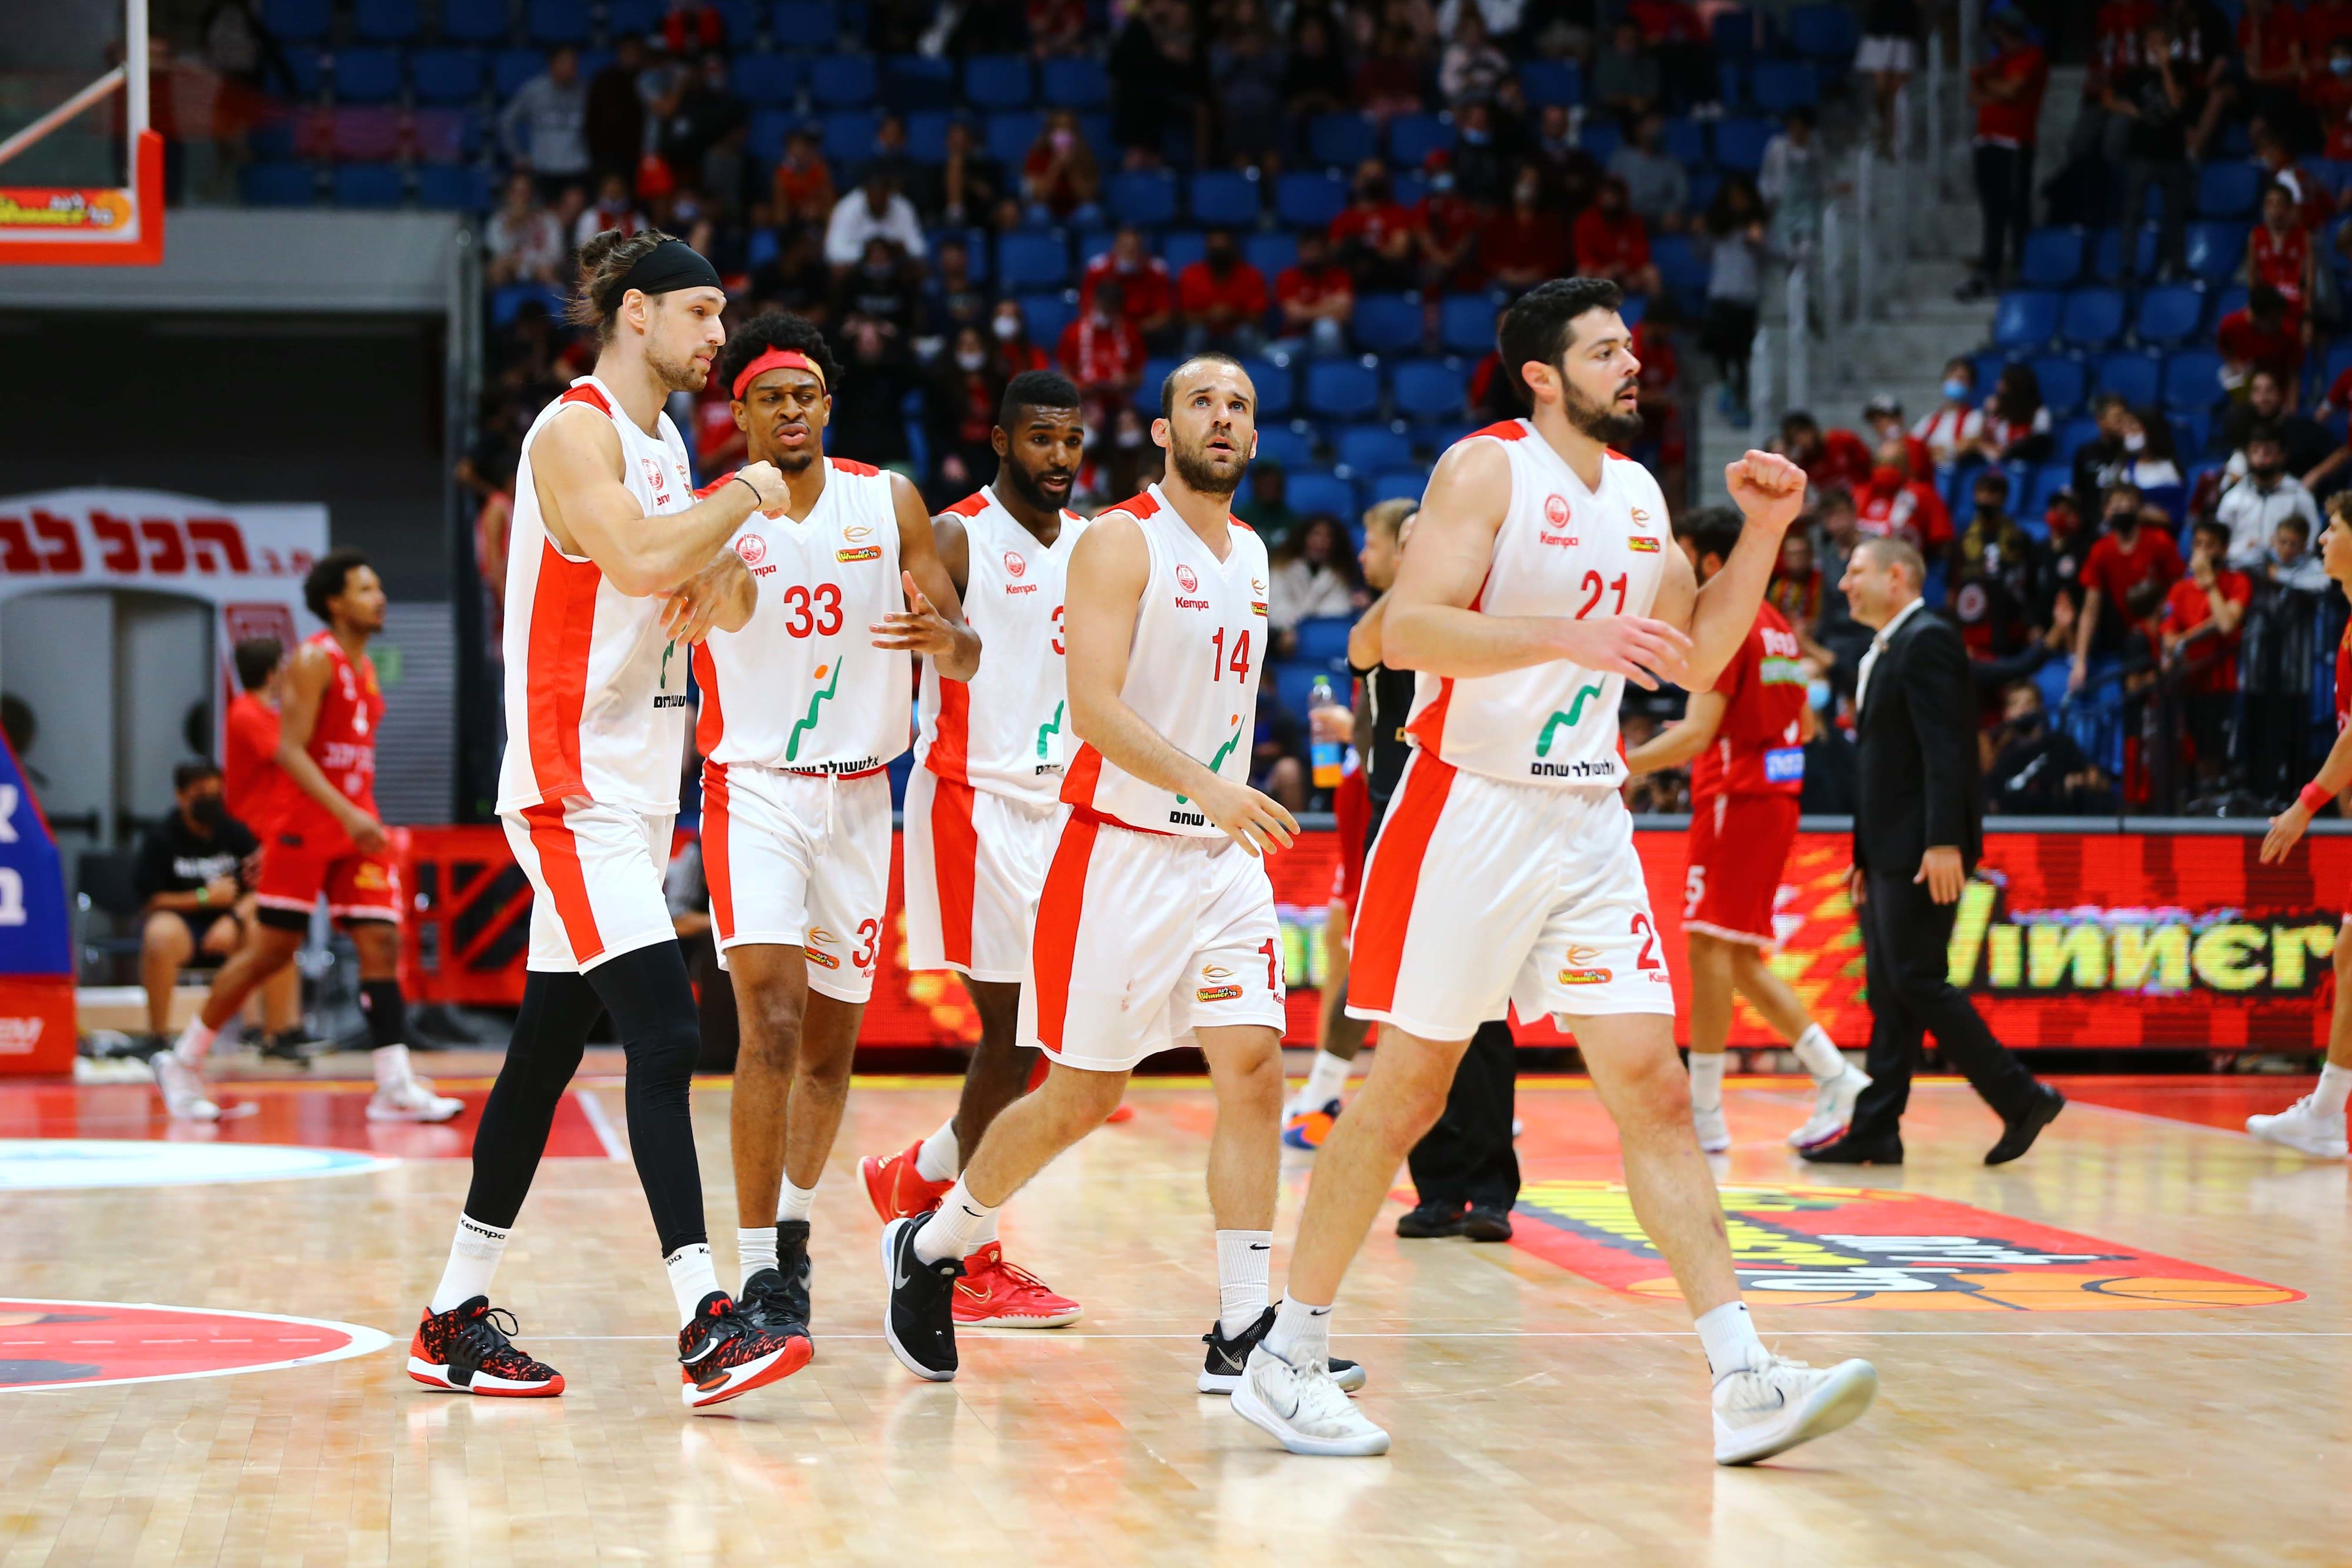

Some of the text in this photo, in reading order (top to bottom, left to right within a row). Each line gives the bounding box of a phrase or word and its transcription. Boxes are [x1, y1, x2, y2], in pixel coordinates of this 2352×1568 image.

[87, 508, 250, 574] הכל
[1540, 530, 1579, 549] Kempa
[1006, 584, 1037, 595] Kempa
[1575, 569, 1627, 620] 21
[784, 583, 843, 638] 33
[1175, 597, 1210, 611] Kempa
[1212, 627, 1250, 684] 14
[1531, 762, 1569, 777] שחם
[1169, 811, 1205, 827] שחם
[1685, 864, 1706, 905] 5
[1201, 991, 1228, 1000] Winner
[461, 1217, 506, 1239] Kempa
